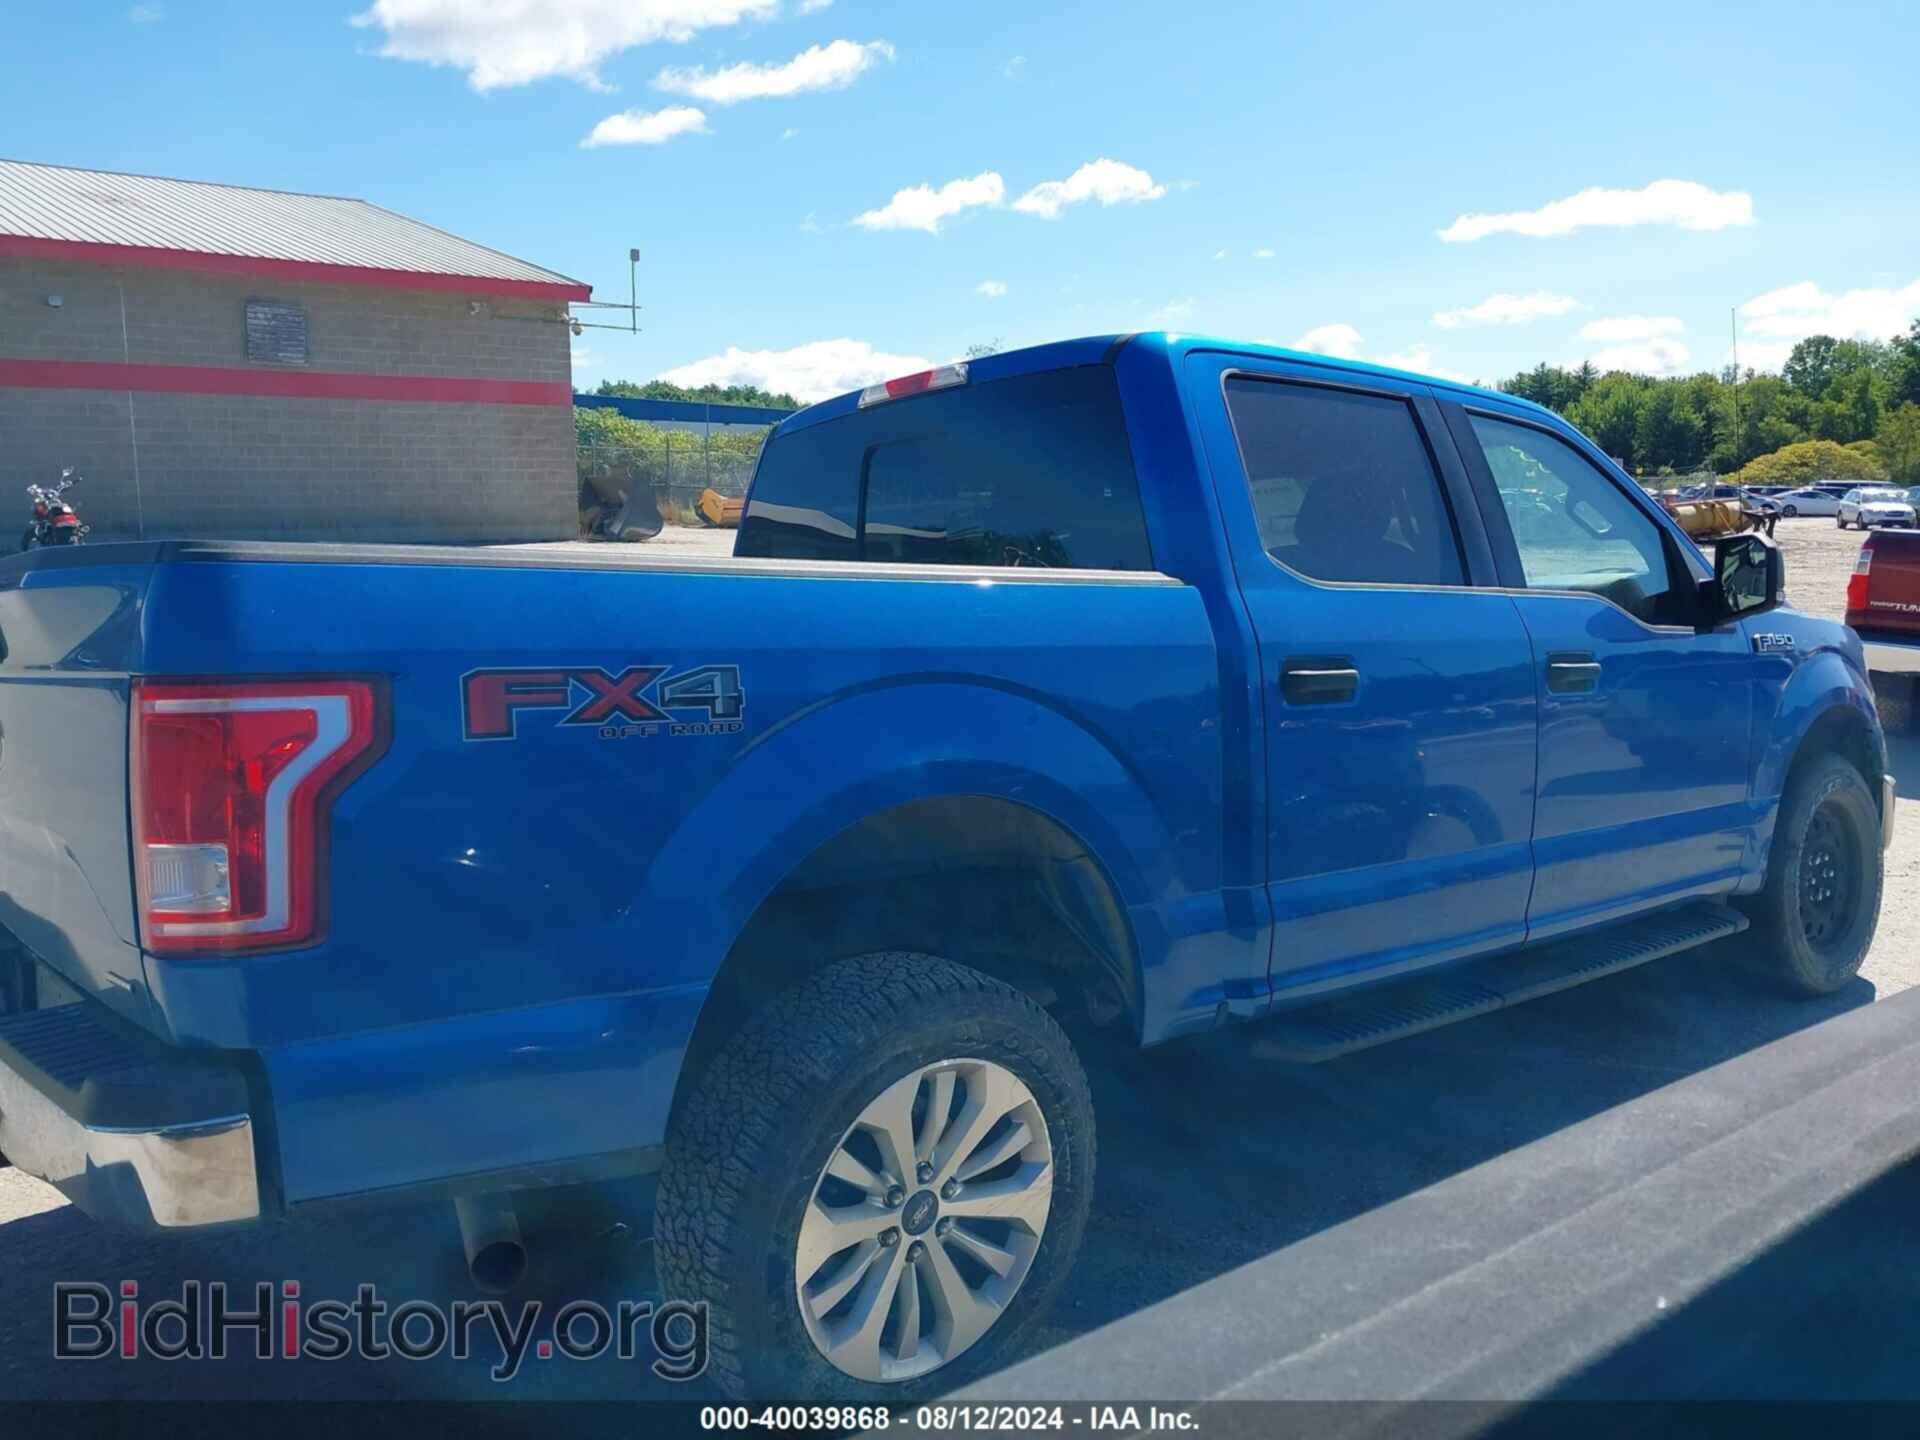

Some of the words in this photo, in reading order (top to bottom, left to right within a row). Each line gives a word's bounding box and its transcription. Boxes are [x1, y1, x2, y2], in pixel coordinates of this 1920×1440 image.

[459, 664, 746, 742] FX4
[599, 724, 659, 740] OFF
[670, 721, 745, 738] ROAD
